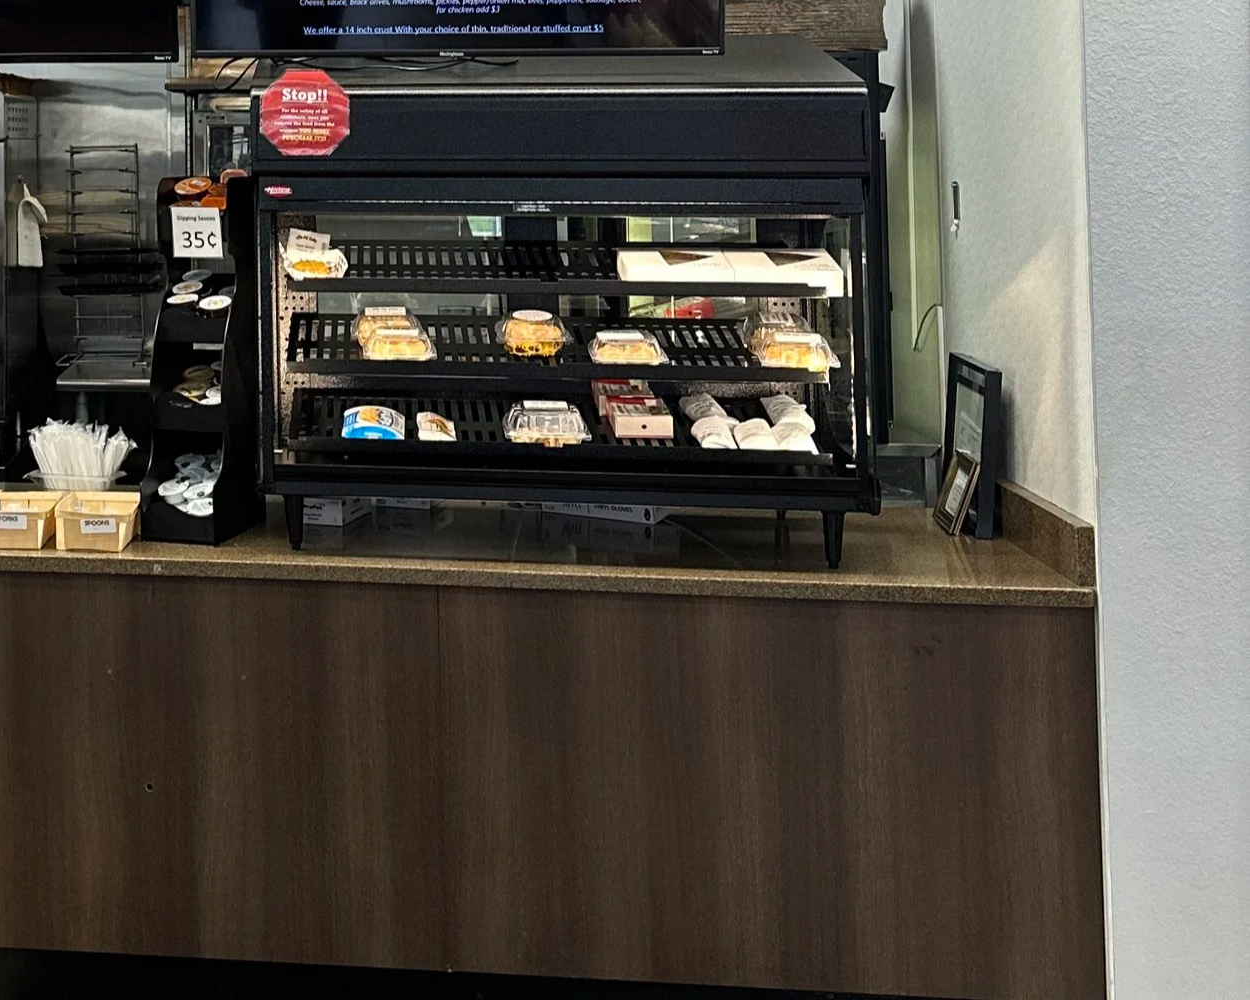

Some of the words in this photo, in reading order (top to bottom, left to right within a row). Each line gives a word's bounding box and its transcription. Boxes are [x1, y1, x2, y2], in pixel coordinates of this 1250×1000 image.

[356, 25, 372, 33] inch
[394, 25, 413, 33] With
[490, 24, 530, 32] traditional
[543, 24, 570, 32] stuffed
[281, 87, 329, 104] Stop!!
[182, 231, 218, 250] 35¢
